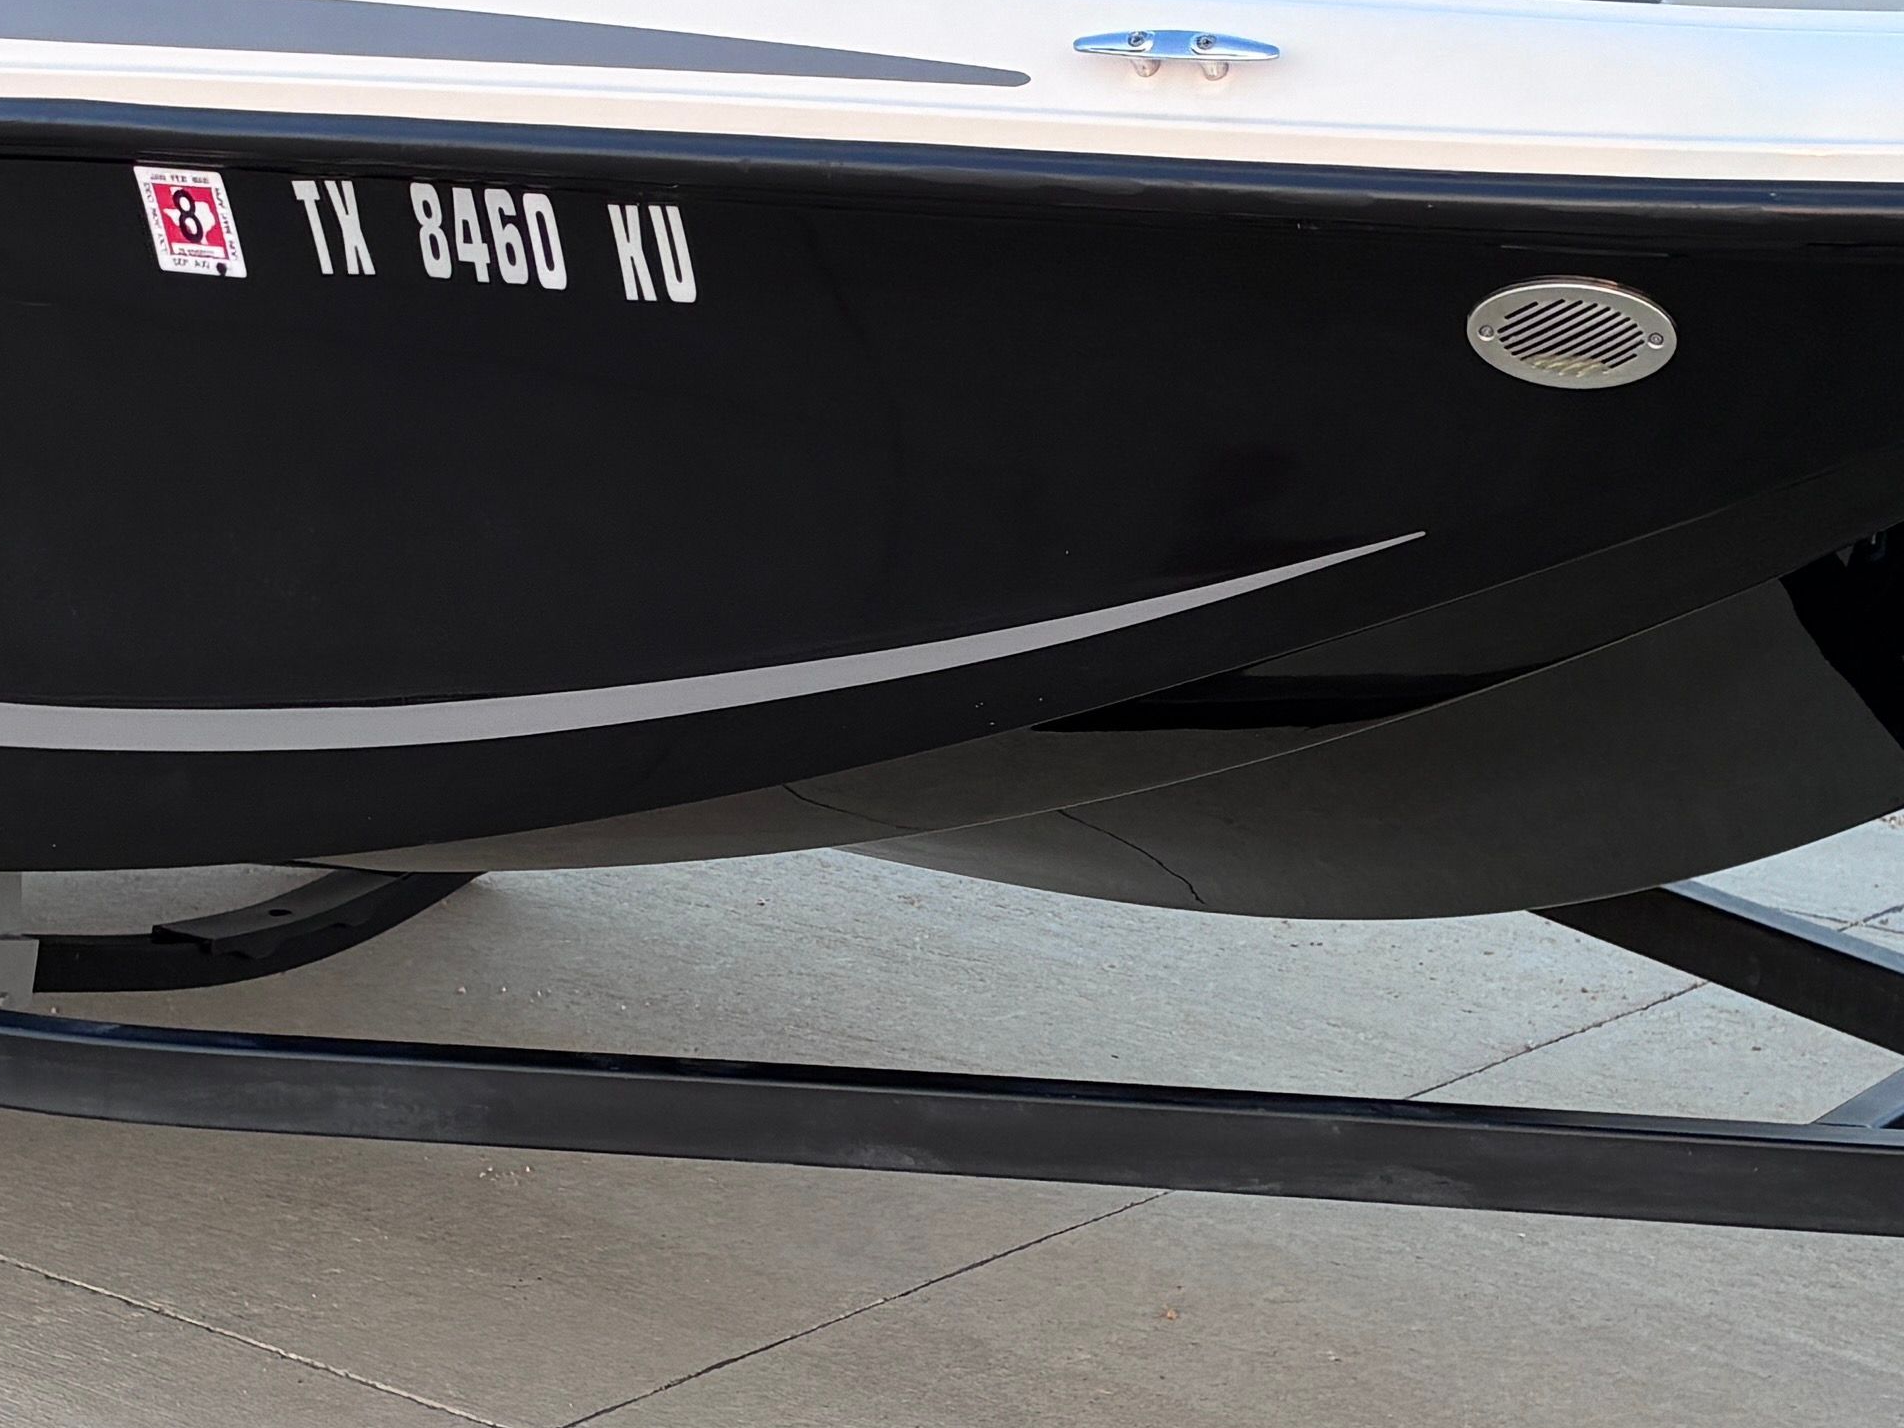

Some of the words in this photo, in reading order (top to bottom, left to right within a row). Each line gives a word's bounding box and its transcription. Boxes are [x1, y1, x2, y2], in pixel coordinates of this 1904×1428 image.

[172, 188, 204, 244] 8
[291, 180, 376, 275] TX
[409, 182, 568, 291] 8460
[607, 203, 697, 303] KU
